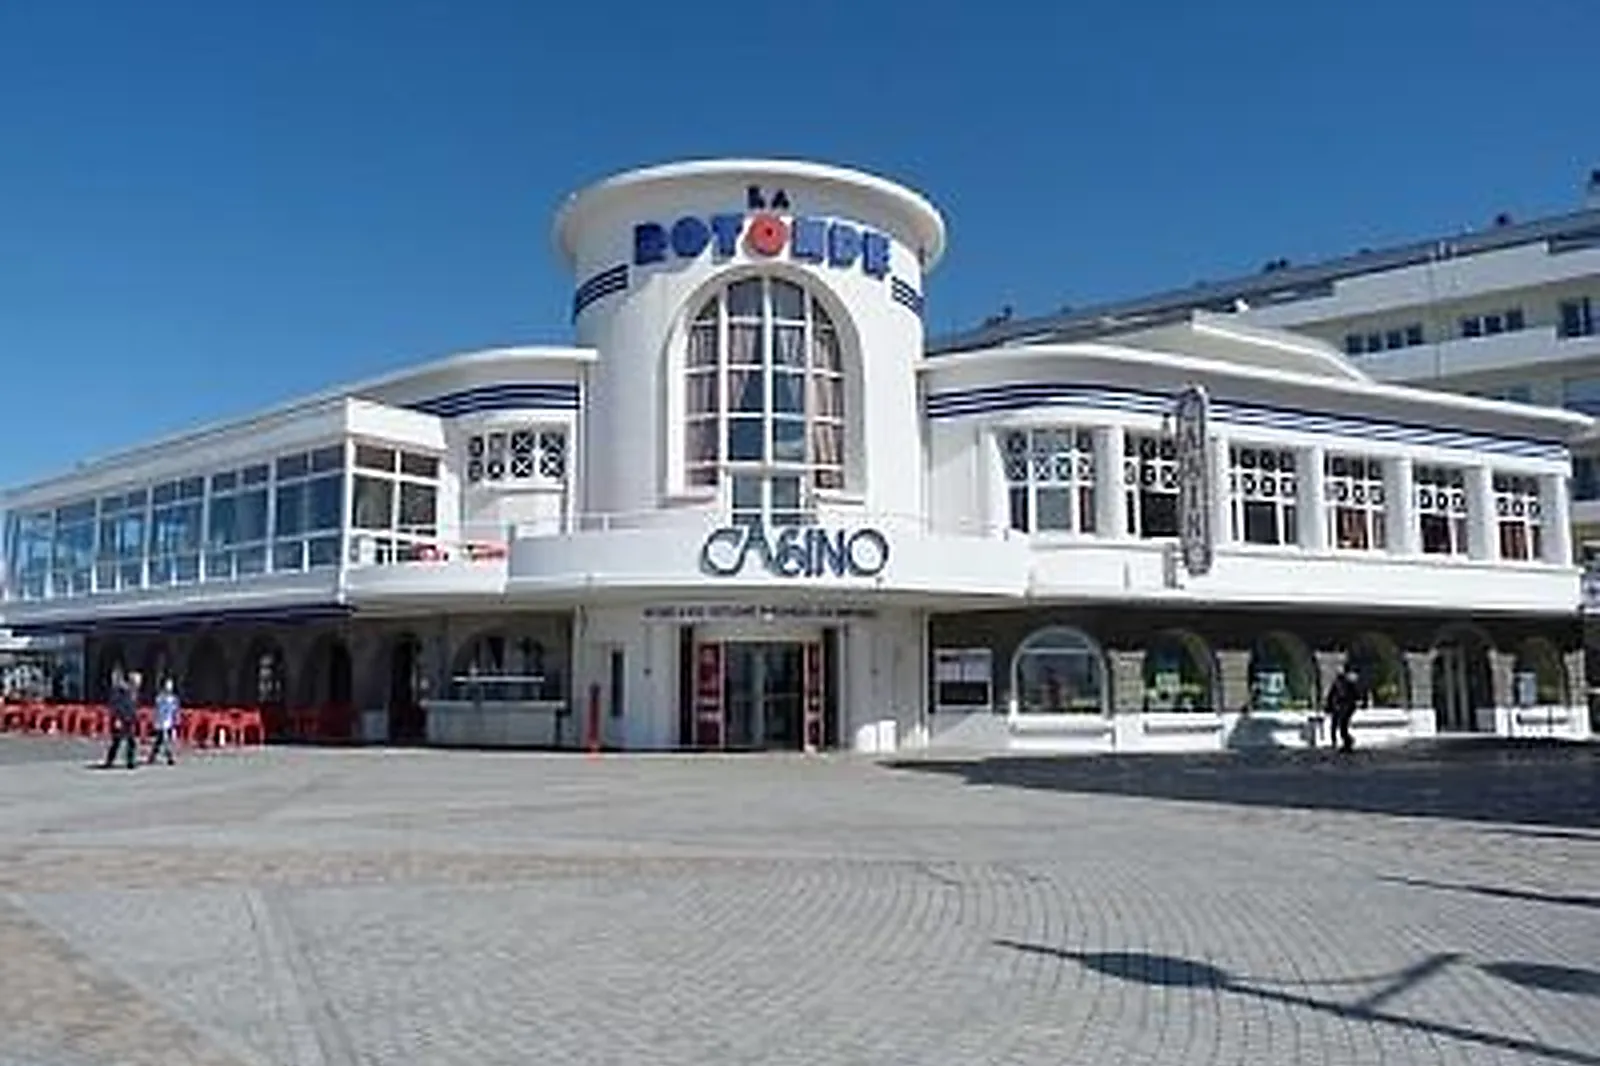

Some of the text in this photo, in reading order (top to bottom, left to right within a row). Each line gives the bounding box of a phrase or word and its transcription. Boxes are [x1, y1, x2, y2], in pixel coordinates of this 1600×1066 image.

[747, 185, 789, 209] LA
[634, 212, 891, 279] ROTONDE
[701, 522, 888, 577] CASINO
